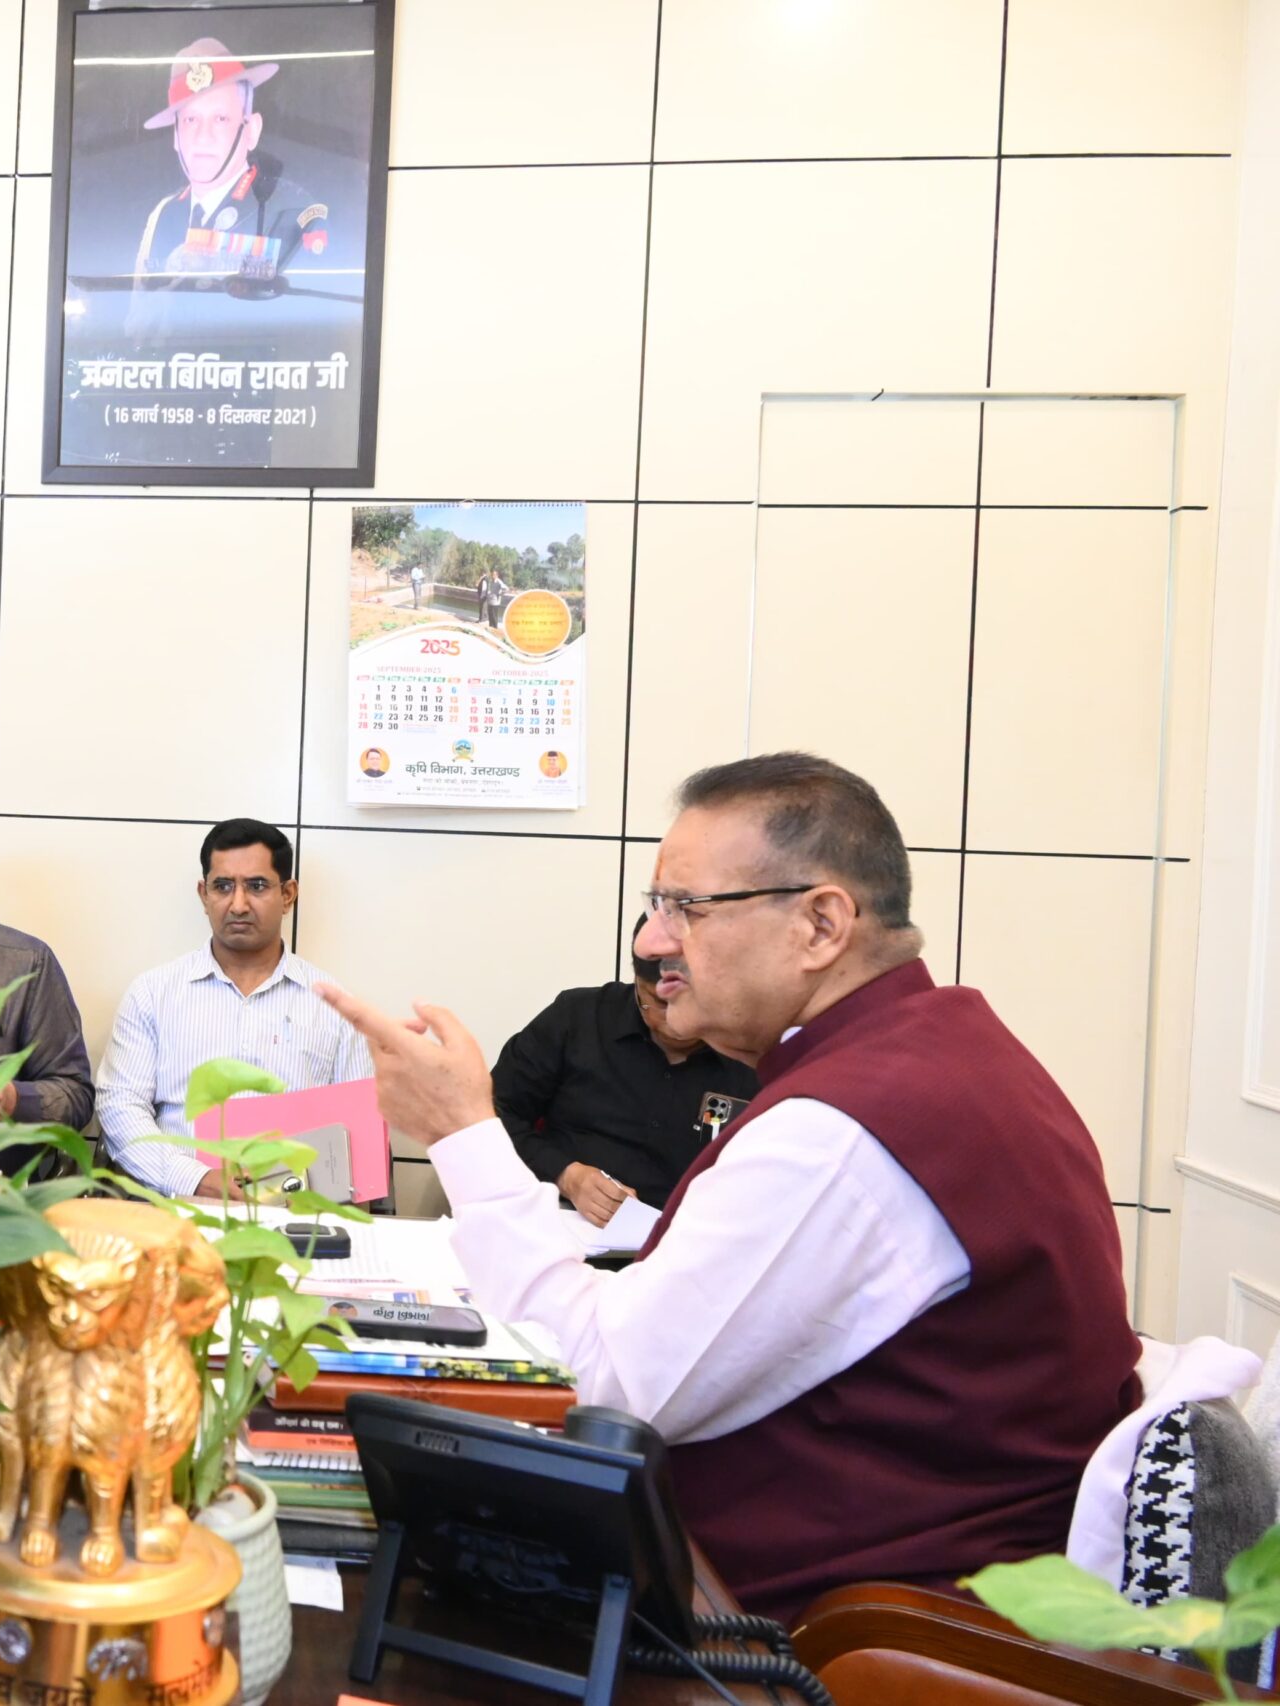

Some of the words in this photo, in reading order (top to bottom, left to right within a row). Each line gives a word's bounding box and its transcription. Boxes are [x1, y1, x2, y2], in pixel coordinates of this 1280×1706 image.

[79, 360, 166, 389] जनरल
[169, 353, 245, 390] बिपिन
[248, 361, 311, 391] रावत
[314, 352, 349, 390] जी
[132, 405, 158, 423] मार्च
[162, 409, 193, 424] 1958
[206, 410, 215, 424] 8
[219, 405, 271, 425] दिसम्बर
[420, 638, 461, 656] 2025
[391, 685, 397, 693] 2
[406, 685, 412, 693] 3
[436, 686, 442, 694] 5
[547, 689, 553, 697] 3
[435, 696, 443, 704] 12
[405, 704, 412, 712] 17
[515, 708, 524, 716] 15
[388, 713, 398, 721] 23
[418, 714, 428, 722] 25
[433, 715, 443, 723] 26
[499, 717, 508, 725] 21
[484, 726, 493, 734] 27
[513, 727, 524, 735] 29
[529, 727, 539, 735] 30
[405, 761, 427, 777] कृषि
[470, 766, 520, 777] उत्तराखण्ड
